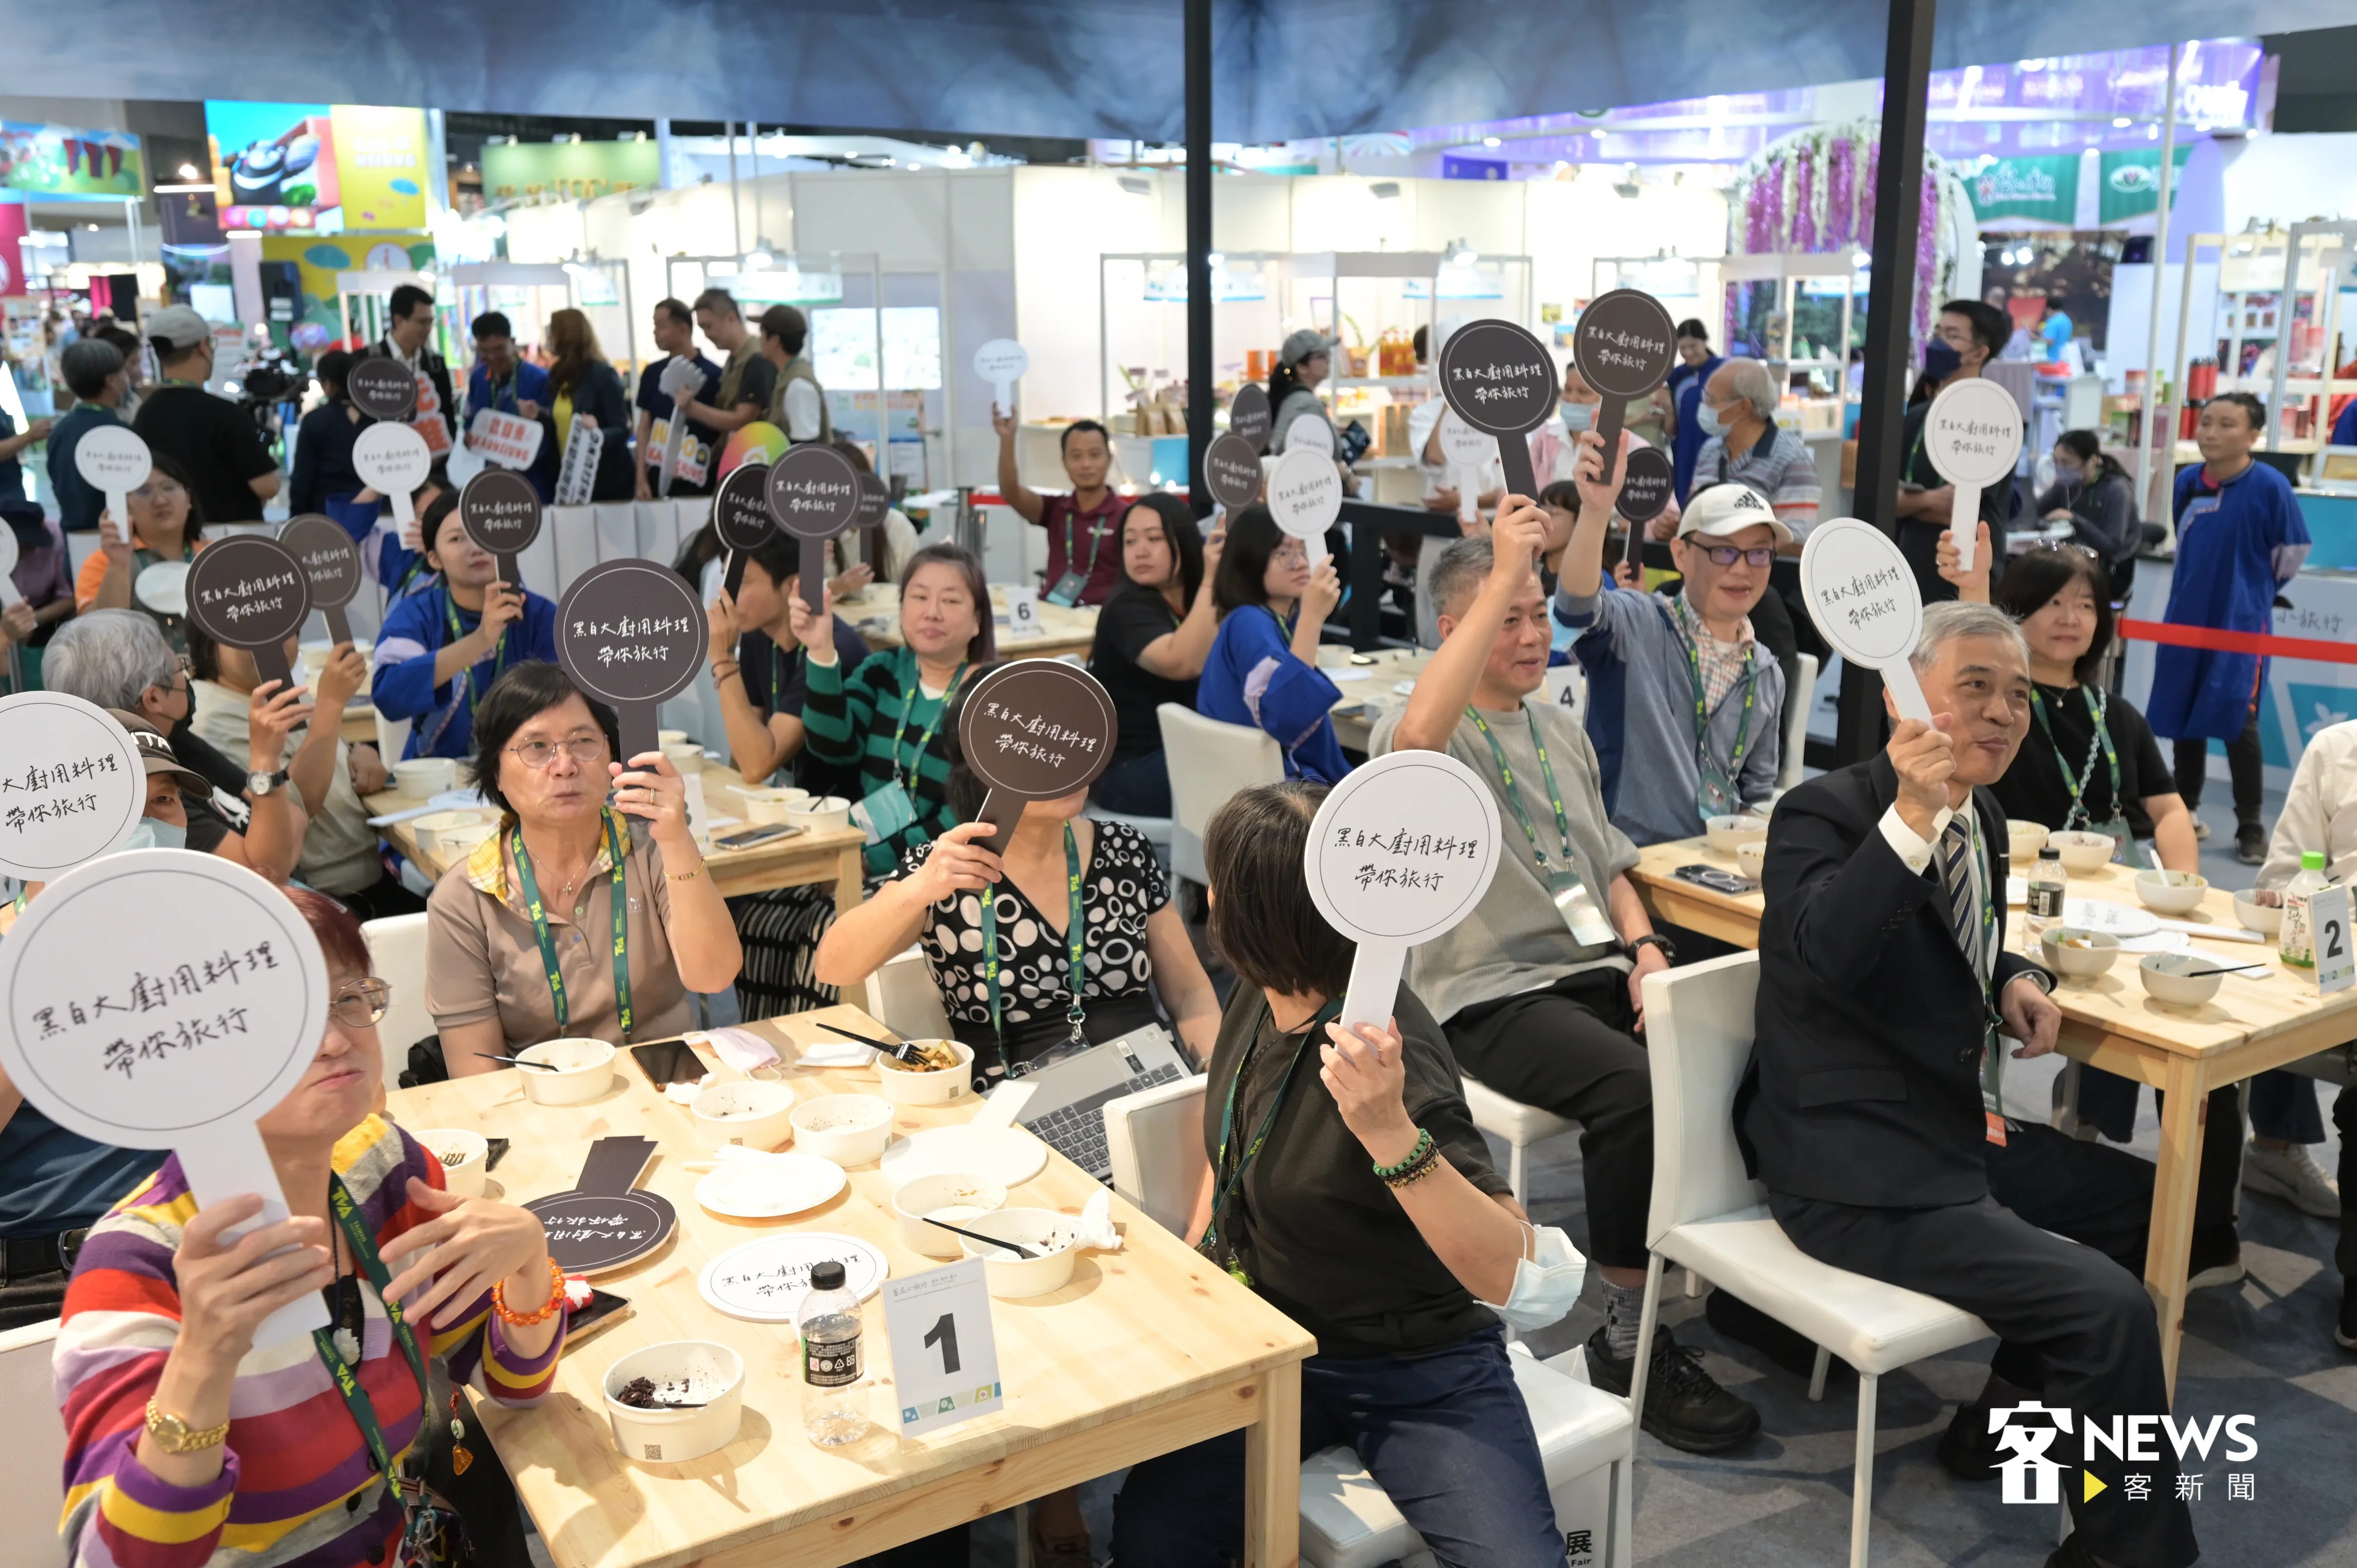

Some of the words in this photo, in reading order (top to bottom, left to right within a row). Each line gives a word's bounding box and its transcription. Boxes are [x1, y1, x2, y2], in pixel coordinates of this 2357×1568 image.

[1587, 325, 1666, 355] 黑白大廚用料理
[1452, 362, 1542, 381] 黑白大廚用料理
[1597, 349, 1647, 371] 帶你旅行
[1475, 386, 1529, 405] 帶你旅行
[1939, 419, 2011, 438] 黑白大廚用料理
[1951, 440, 1996, 457] 帶你旅行
[201, 571, 295, 605] 黑白大廚用料理
[1821, 566, 1900, 606] 黑白大廚用料理
[226, 597, 283, 623] 帶你旅行
[1017, 602, 1030, 620] 6
[1848, 598, 1897, 630] 帶你旅行
[573, 616, 689, 638] 黑白大廚用料理
[597, 644, 669, 667] 帶你旅行
[1559, 686, 1575, 707] 4
[983, 702, 1097, 752] 黑白大廚用料理
[995, 733, 1065, 768] 帶你旅行
[1, 753, 118, 792] 大廚用料理
[5, 794, 97, 834] 帶你旅行
[1334, 827, 1478, 860] 黑白大廚用料理
[1354, 863, 1444, 891] 帶你旅行
[2325, 919, 2343, 959] 2
[32, 941, 281, 1041] 黑白大廚用料理
[103, 1007, 249, 1079] 帶你旅行
[544, 1214, 629, 1226] 帶你旅行
[924, 1312, 961, 1375] 1
[1565, 1530, 1593, 1556] 展
[1571, 1558, 1592, 1567] Fair
